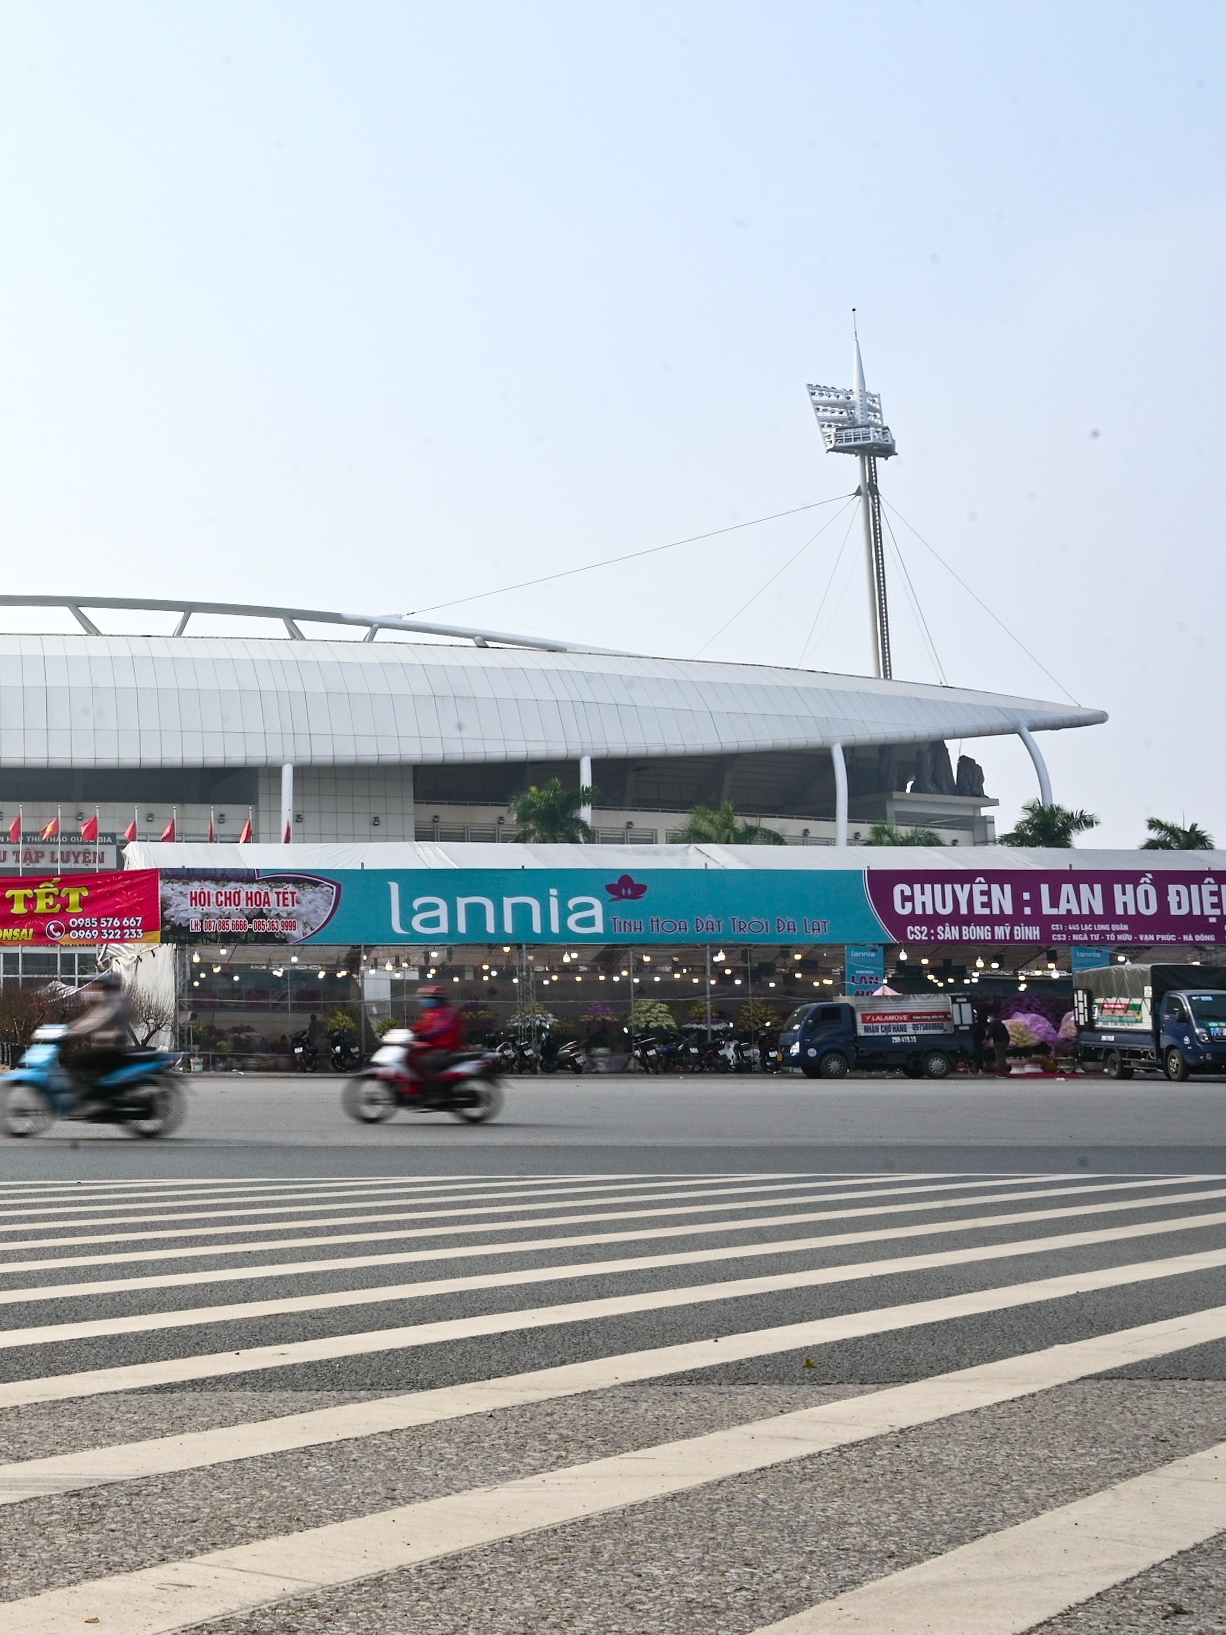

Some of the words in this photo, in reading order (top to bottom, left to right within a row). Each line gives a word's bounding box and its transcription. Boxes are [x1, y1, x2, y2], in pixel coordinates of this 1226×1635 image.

[12, 848, 44, 866] TẬP
[50, 848, 104, 866] LUYỆN
[5, 877, 90, 914] TẾT
[189, 887, 212, 910] HỘI
[214, 888, 242, 911] CHỢ
[245, 890, 271, 908] HOA
[274, 885, 297, 908] TẾT
[893, 877, 1013, 915] CHUYÊN
[1040, 884, 1104, 915] LAN
[1113, 873, 1158, 916] HỒ
[1168, 877, 1226, 923] ĐIỆ
[386, 881, 604, 934] lannia
[69, 918, 98, 928] 0985
[100, 917, 121, 928] 576
[122, 917, 143, 927] 667
[190, 919, 201, 932] LH:
[204, 919, 216, 932] 087
[217, 919, 230, 932] 885
[231, 919, 248, 932] 6666
[253, 919, 266, 932] 085
[267, 919, 279, 932] 363
[280, 919, 297, 932] 9999
[69, 930, 98, 940] 0969
[101, 930, 121, 940] 322
[123, 929, 144, 939] 233
[907, 926, 928, 940] CS2
[937, 923, 960, 940] SÂN
[962, 923, 992, 940] BÓNG
[994, 924, 1011, 940] MỸ
[1013, 923, 1040, 940] ĐÌNH
[852, 976, 879, 984] LAN
